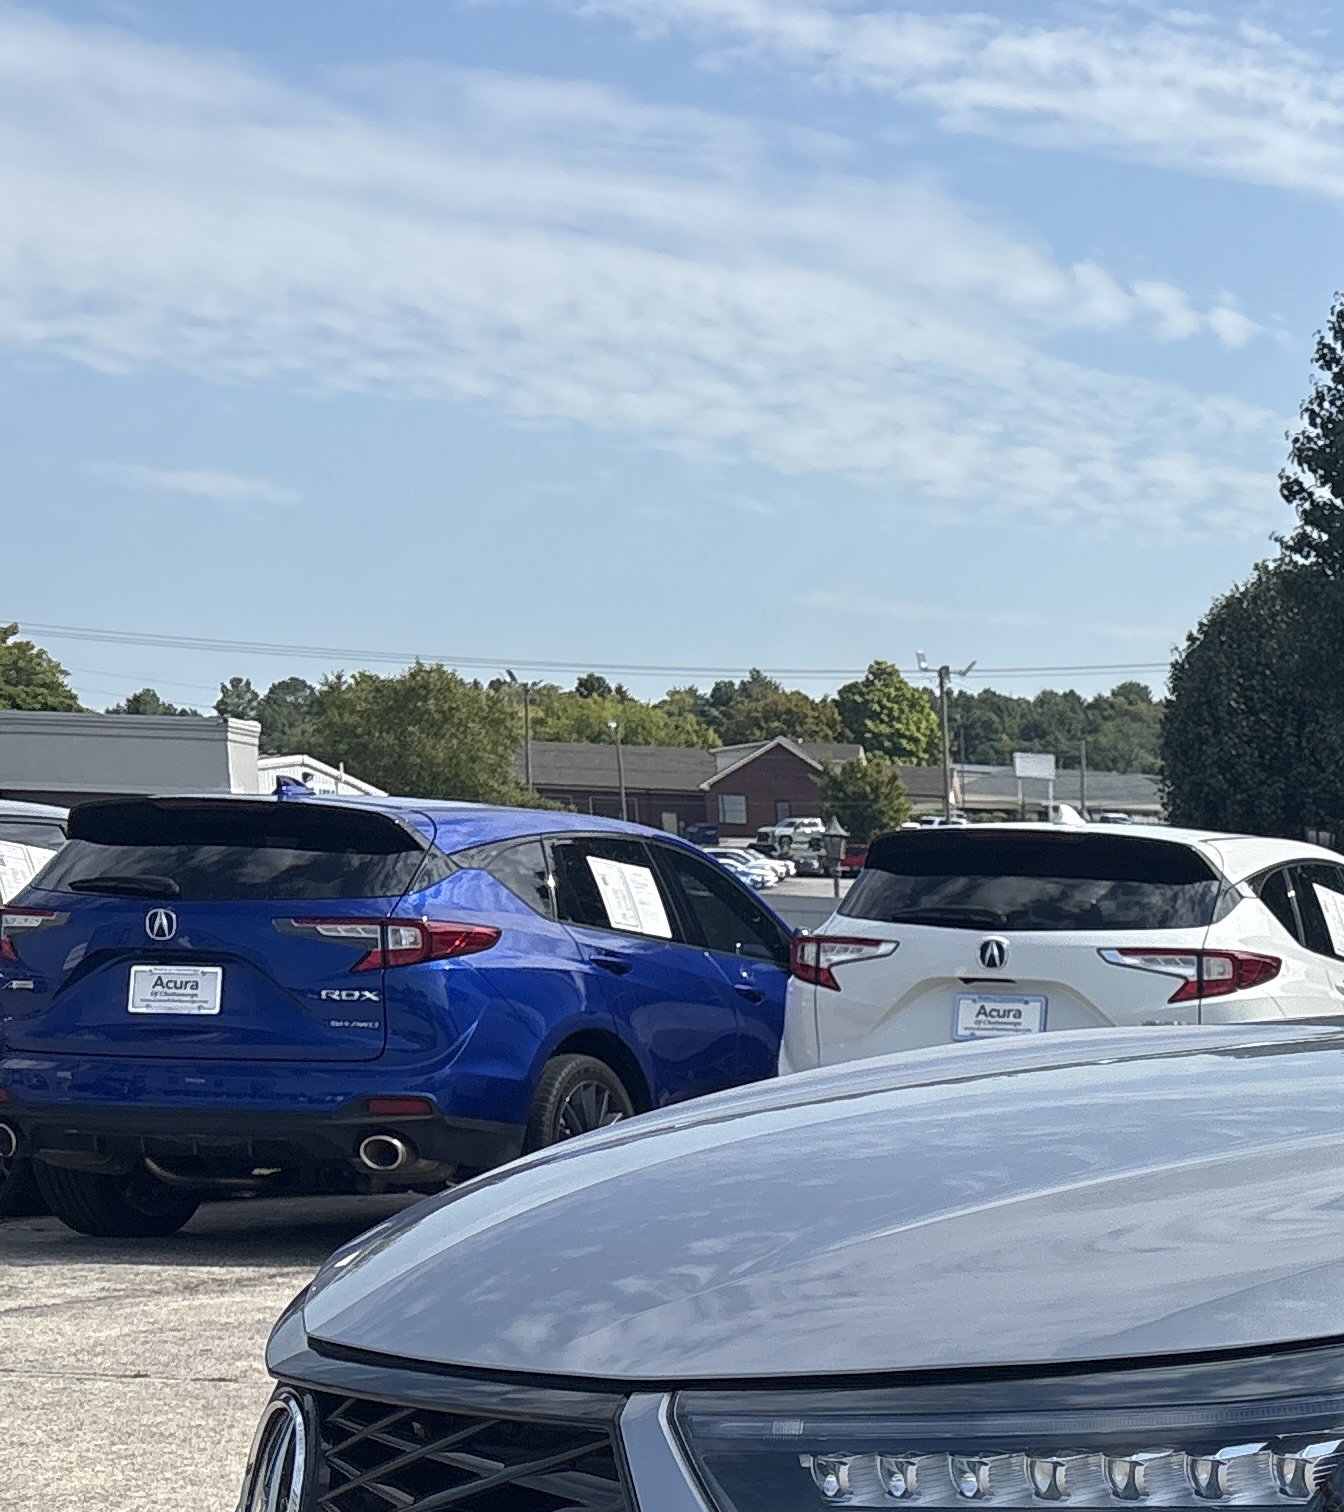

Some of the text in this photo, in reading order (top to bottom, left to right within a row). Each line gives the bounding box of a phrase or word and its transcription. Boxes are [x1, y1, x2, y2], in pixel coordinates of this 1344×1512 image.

[152, 975, 199, 991] Acura
[321, 989, 379, 1001] RDX
[975, 1004, 1023, 1019] Acura
